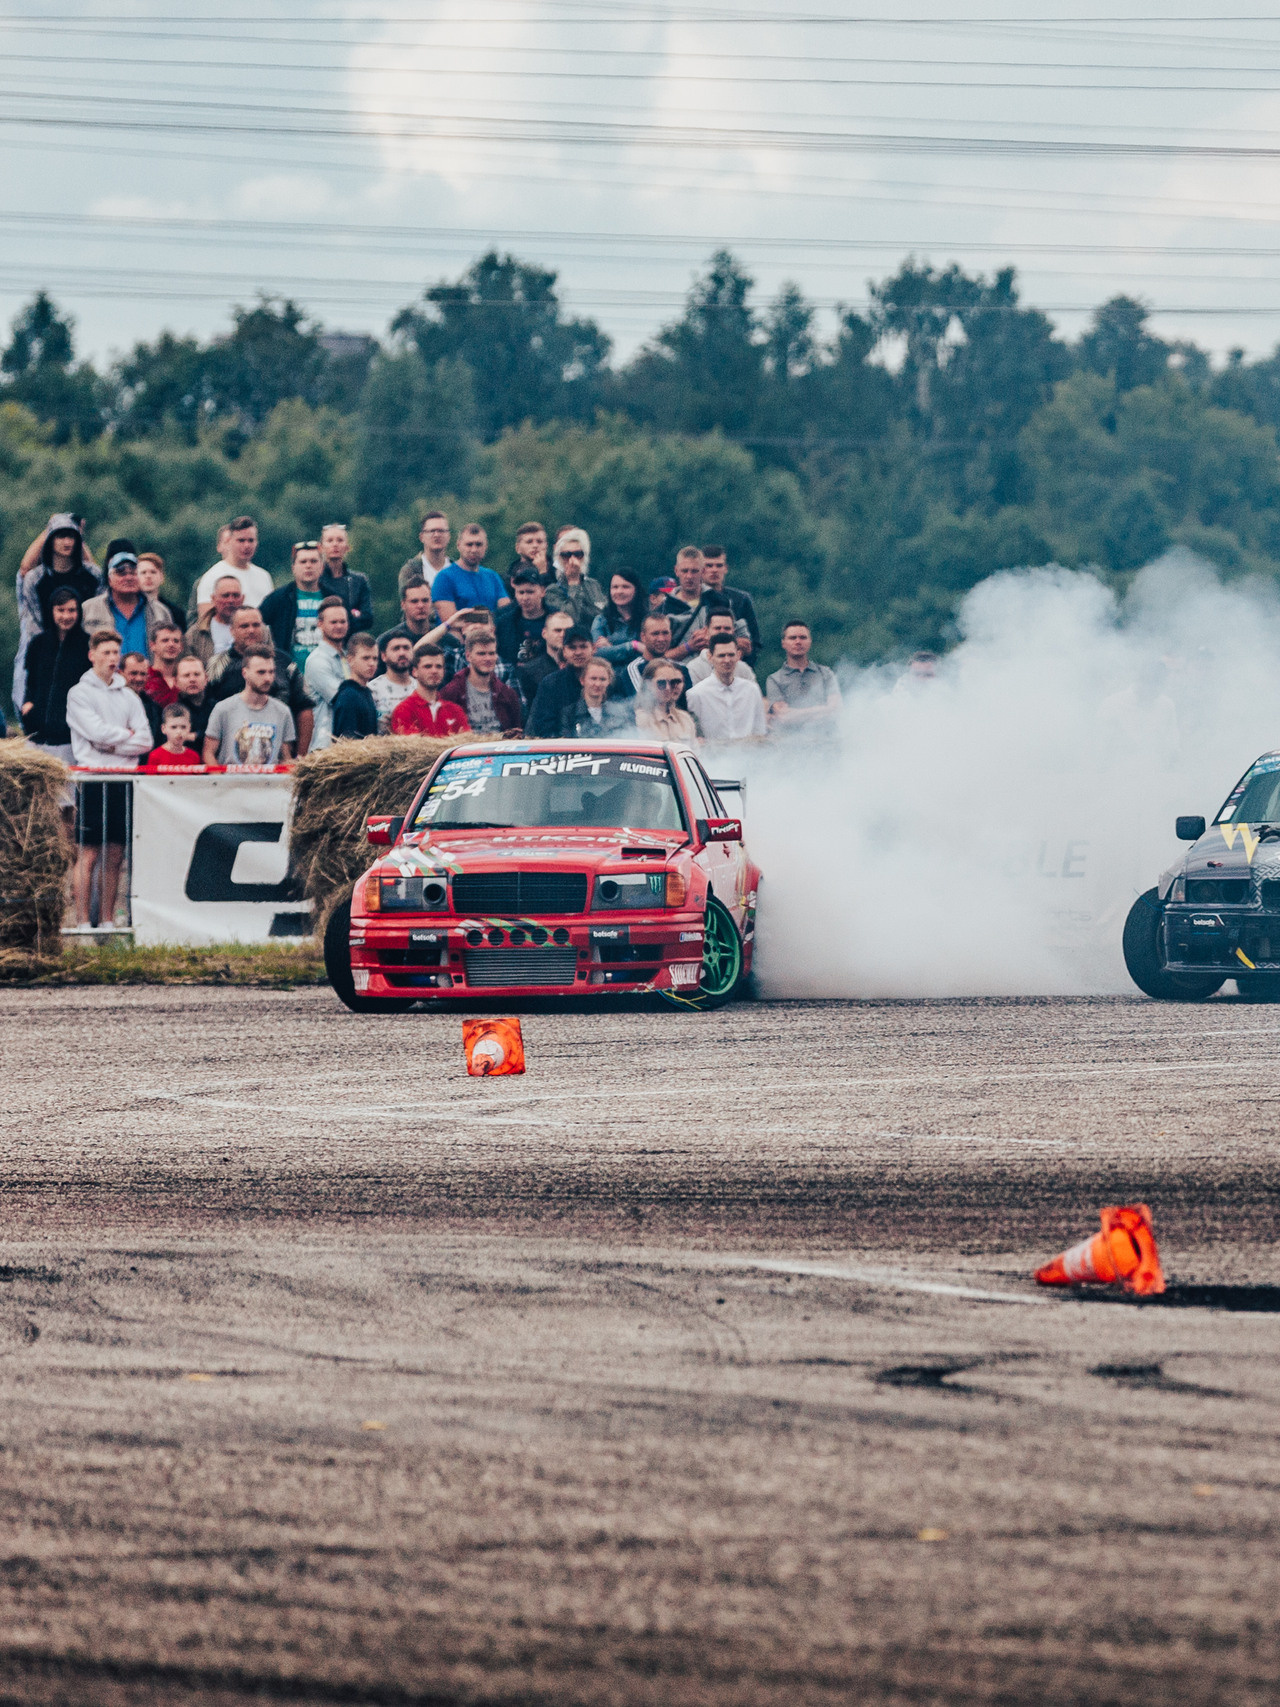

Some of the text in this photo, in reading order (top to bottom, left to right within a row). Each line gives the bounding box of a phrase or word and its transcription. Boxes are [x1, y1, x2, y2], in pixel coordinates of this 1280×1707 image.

[502, 757, 611, 777] DRIFT
[619, 763, 669, 777] #LVDRIFT
[441, 777, 488, 801] 54
[593, 930, 618, 938] betsafe
